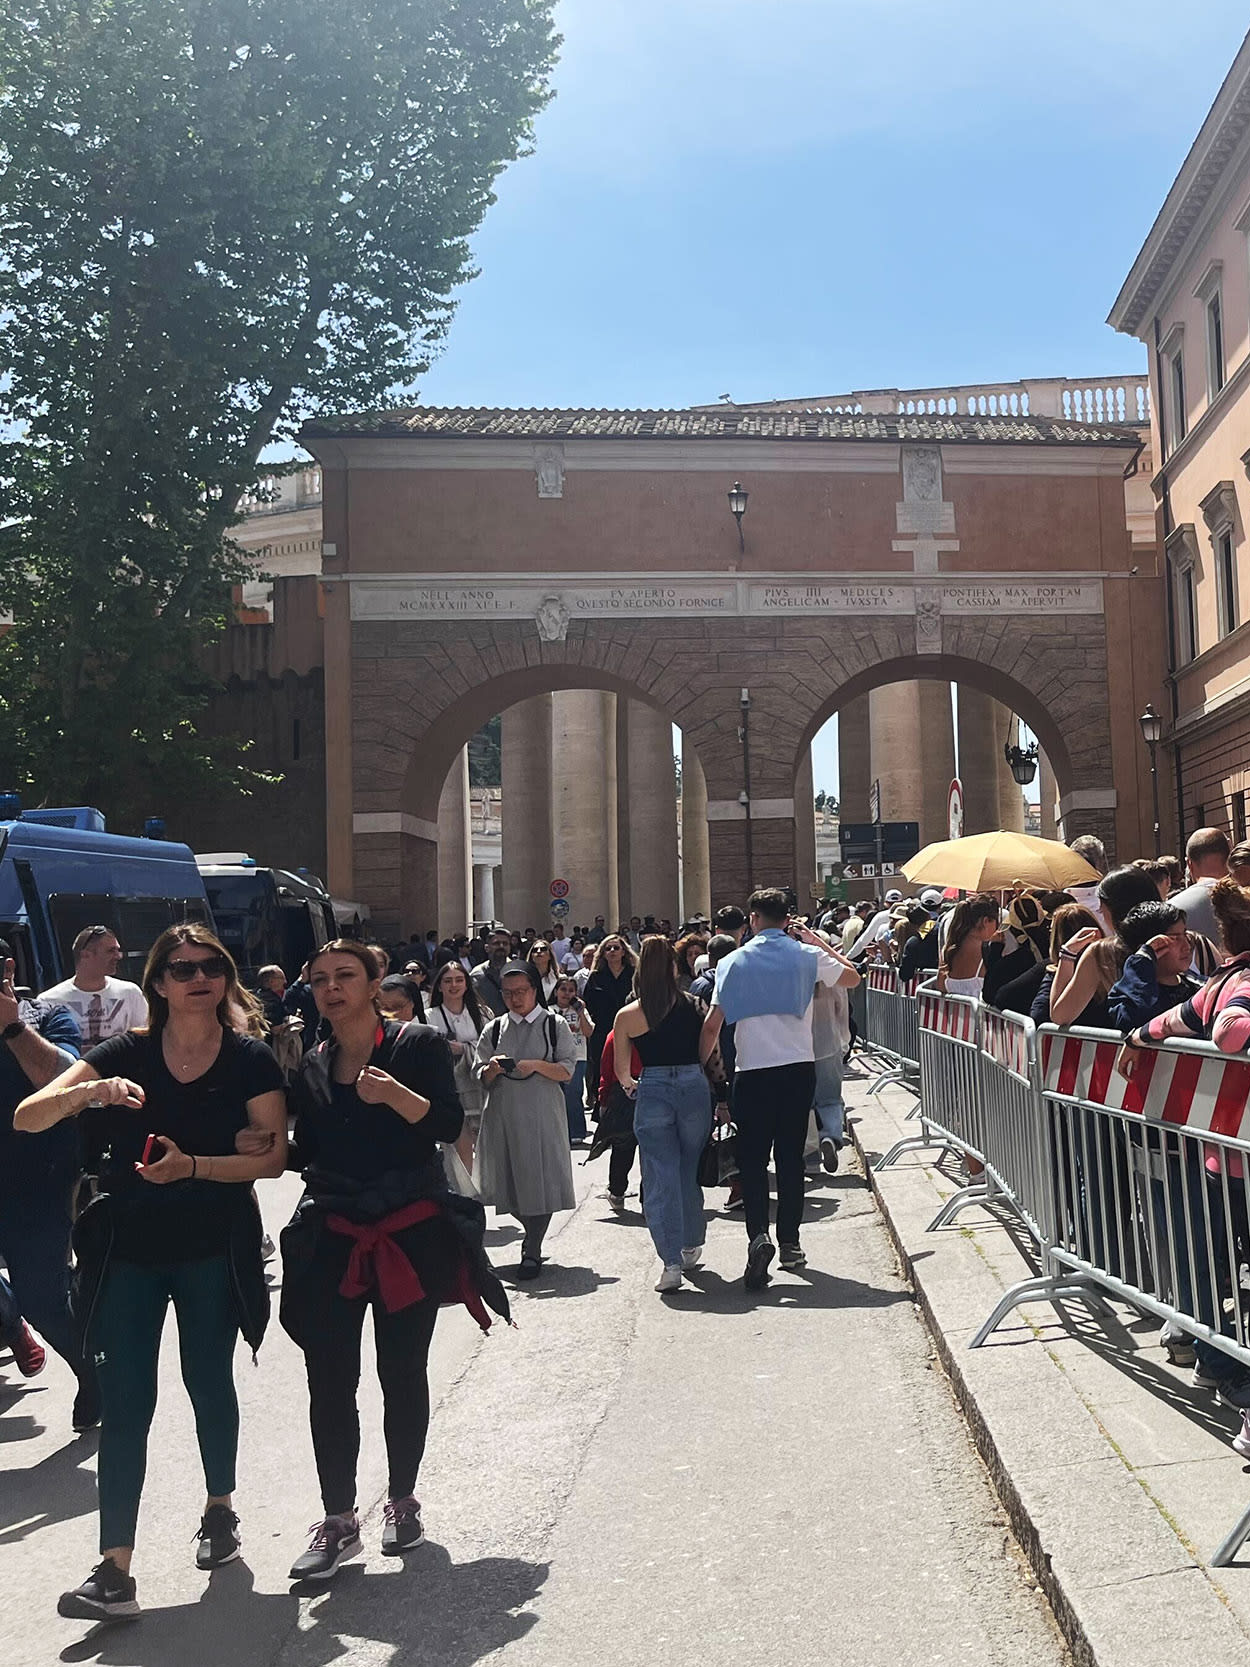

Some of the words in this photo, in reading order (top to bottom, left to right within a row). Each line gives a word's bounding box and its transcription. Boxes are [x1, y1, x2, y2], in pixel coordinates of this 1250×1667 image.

[461, 591, 494, 600] ANNO
[630, 589, 676, 598] APERTO
[765, 588, 789, 597] PIVS
[840, 588, 894, 597] MEDICES
[943, 588, 995, 597] PONTIFEX
[1005, 588, 1028, 597] MAX
[623, 599, 676, 608] SECONDO
[679, 598, 725, 608] FORNICE
[763, 598, 830, 607] ANGELICAM
[957, 598, 1000, 606] CASSIAM
